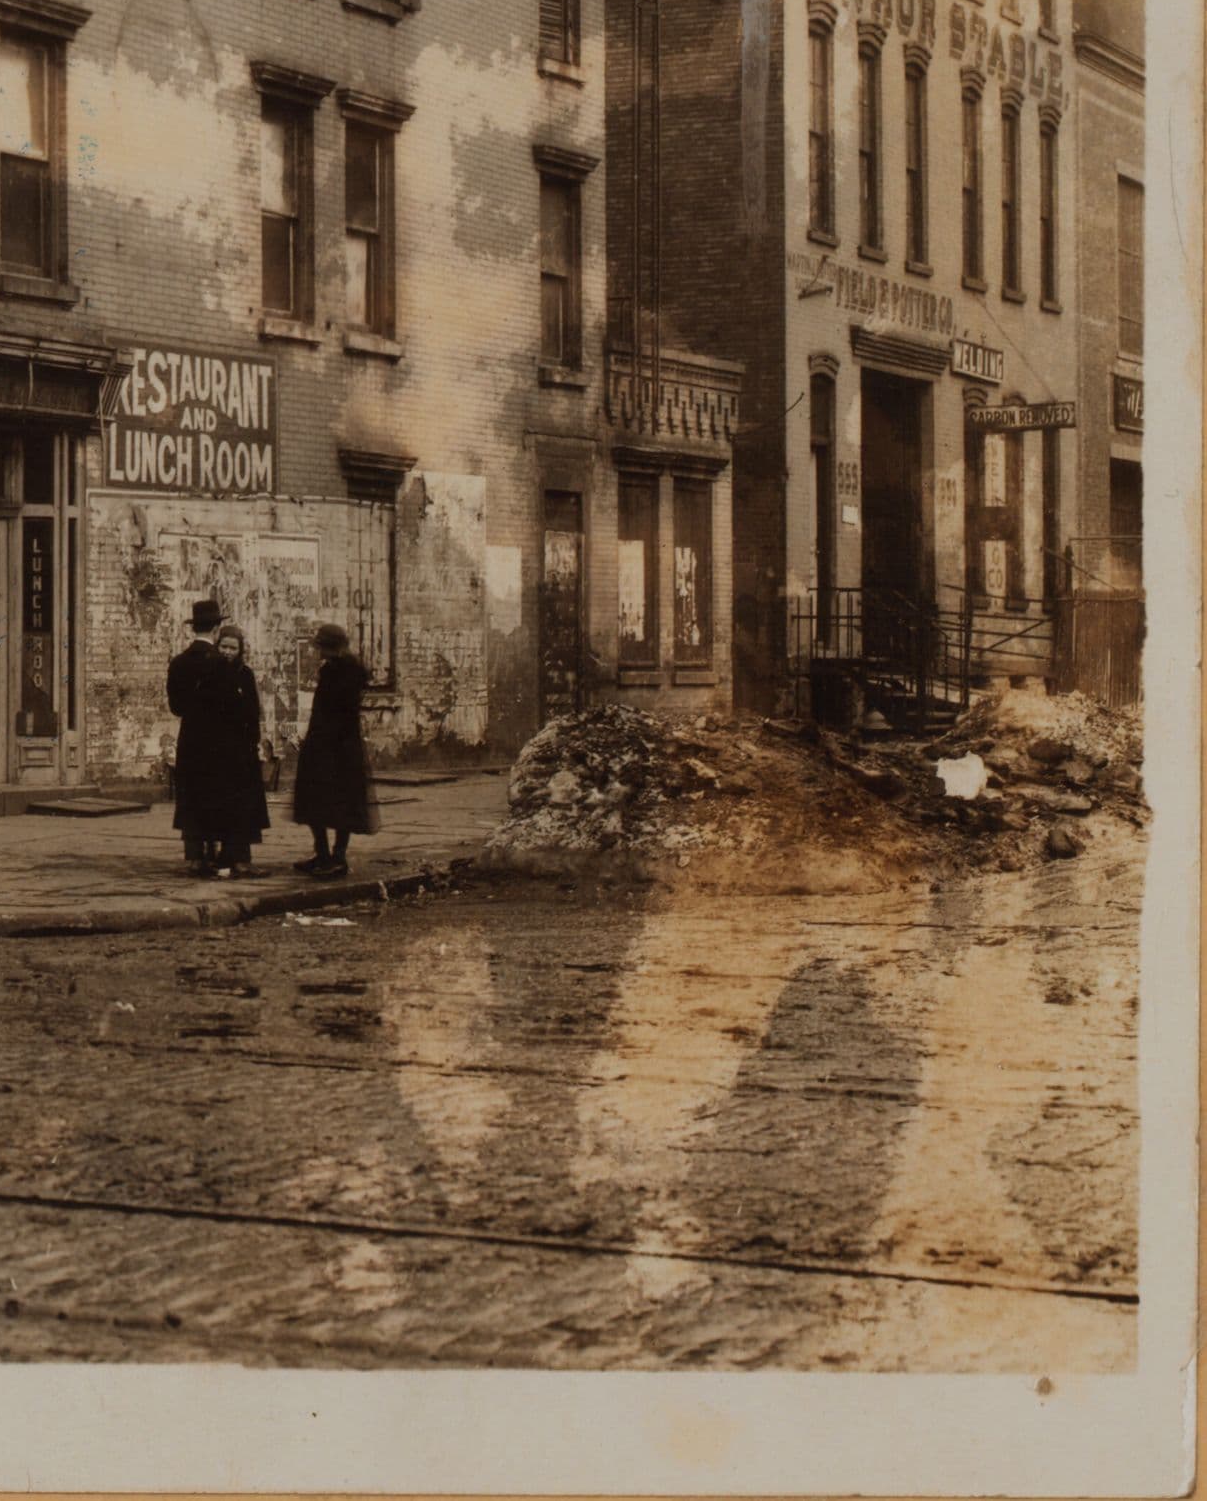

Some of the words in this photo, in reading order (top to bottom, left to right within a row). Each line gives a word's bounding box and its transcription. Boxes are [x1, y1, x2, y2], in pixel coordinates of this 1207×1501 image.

[180, 407, 217, 432] AND
[109, 422, 192, 487] LUNCH
[199, 434, 272, 492] ROOM
[31, 538, 42, 628] LUNCH
